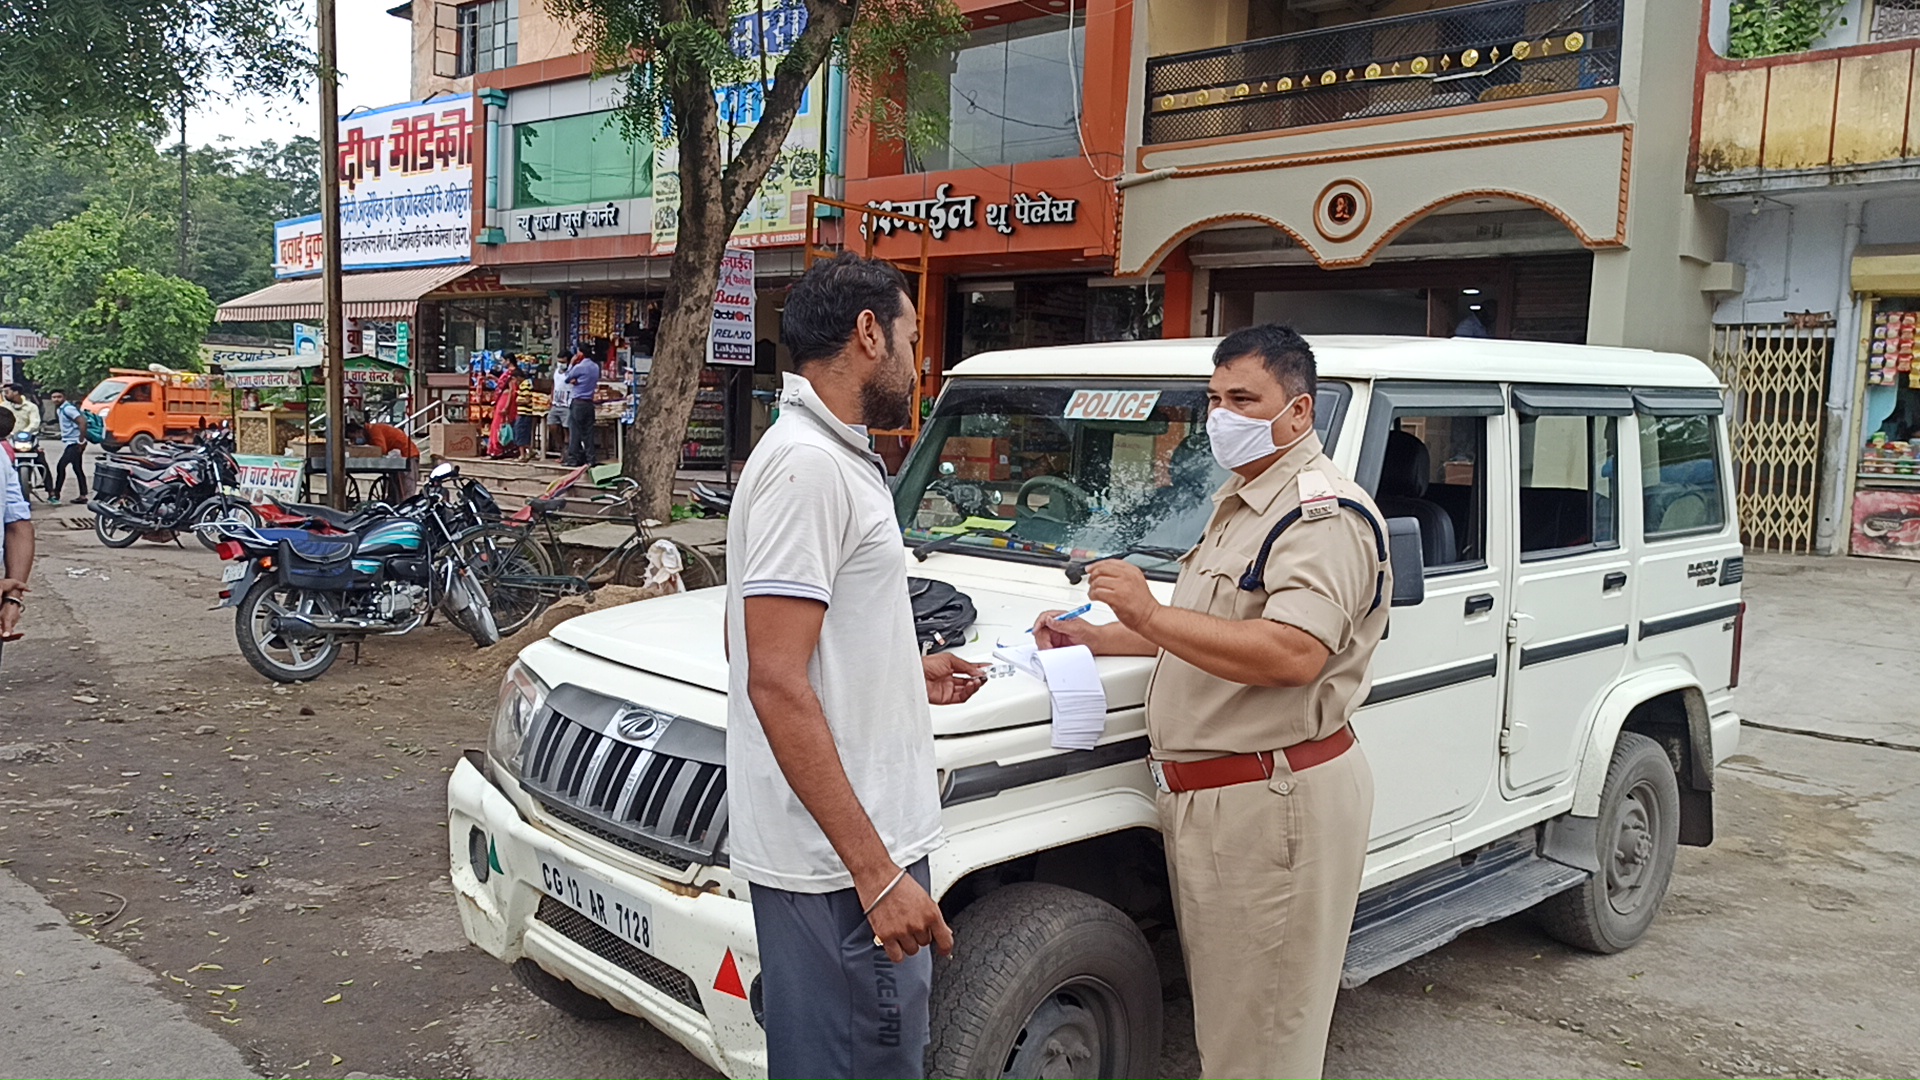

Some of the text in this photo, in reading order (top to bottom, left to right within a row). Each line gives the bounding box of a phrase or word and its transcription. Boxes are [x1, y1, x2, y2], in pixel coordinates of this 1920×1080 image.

[516, 213, 533, 239] न्यू
[534, 212, 558, 231] राजा
[560, 210, 583, 236] जूस
[985, 203, 1012, 233] शू
[1013, 191, 1076, 224] पैलेस
[280, 231, 304, 265] दवाई
[715, 289, 750, 306] Bata
[714, 328, 752, 340] RELAXO
[1067, 392, 1155, 418] POLICE
[250, 466, 269, 486] चाट
[270, 461, 298, 488] सेन्टर
[542, 862, 650, 948] CG 12 AR 7128
